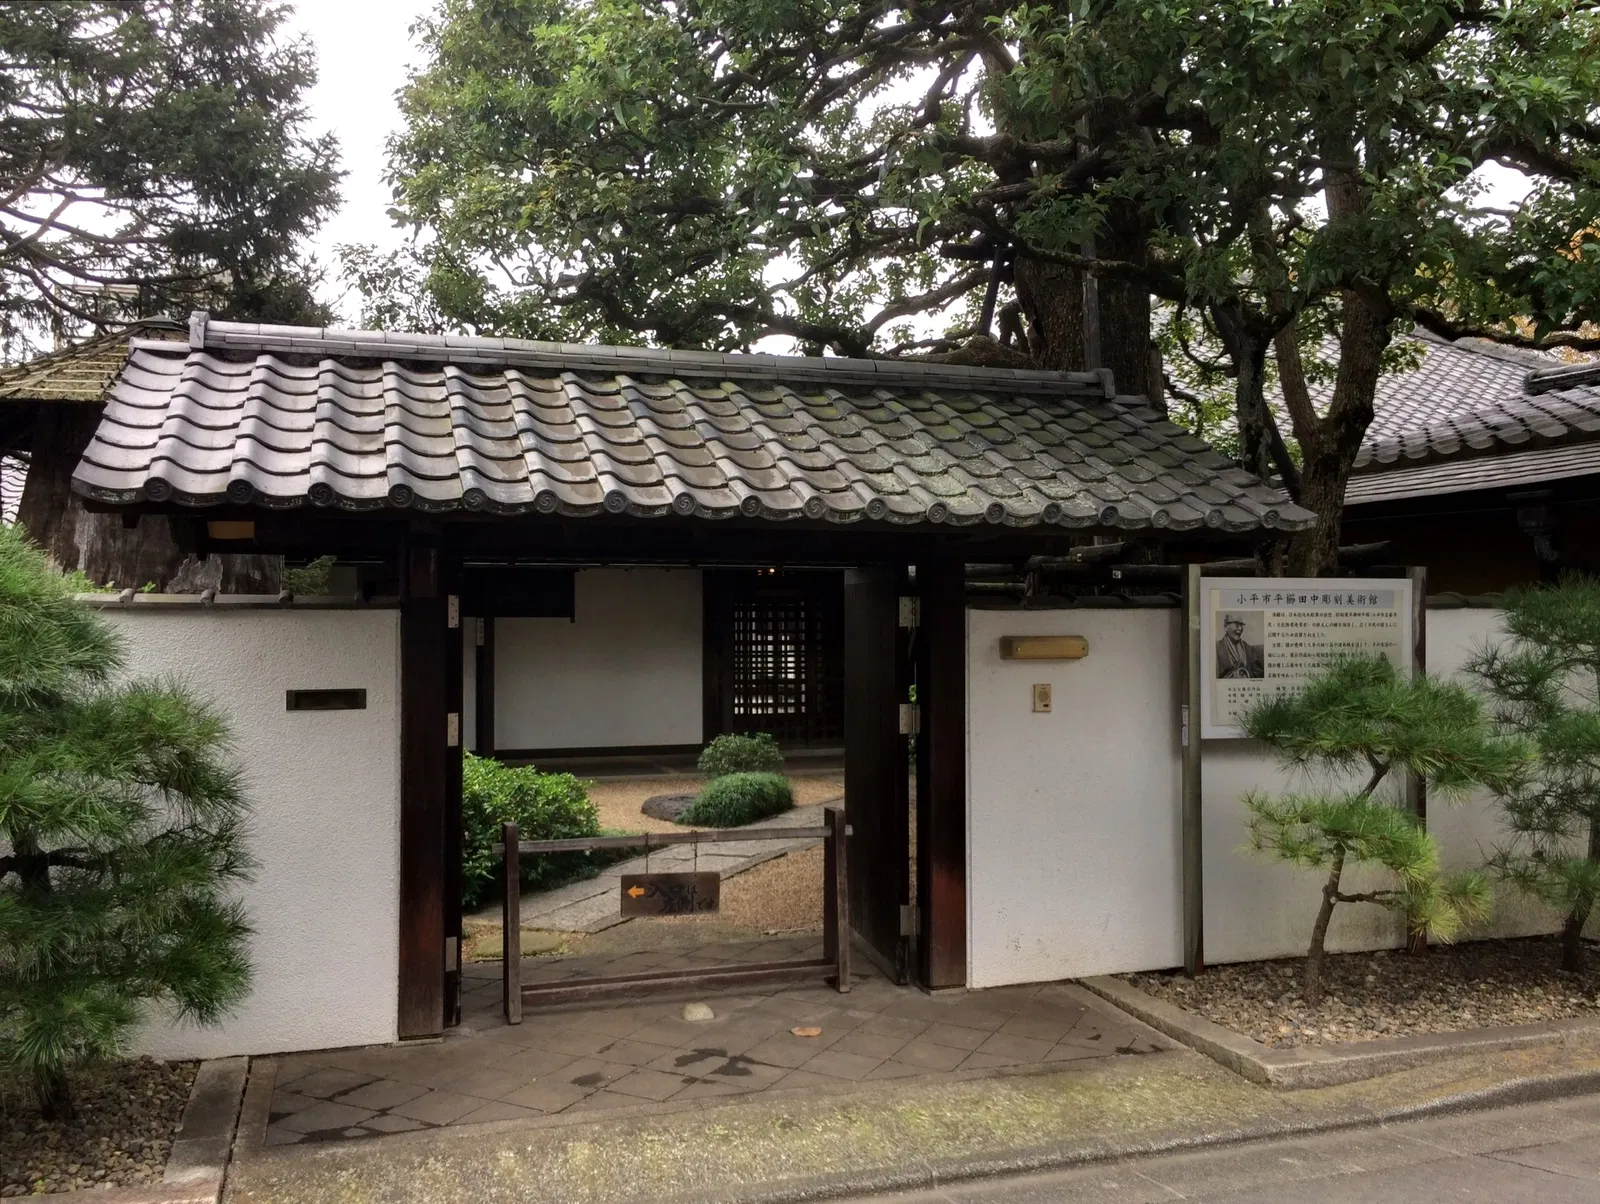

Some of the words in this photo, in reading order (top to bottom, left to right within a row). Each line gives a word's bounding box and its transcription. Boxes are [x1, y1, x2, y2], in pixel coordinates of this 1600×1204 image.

[1237, 593, 1379, 606] 小平市平櫛田中彫刻美術館
